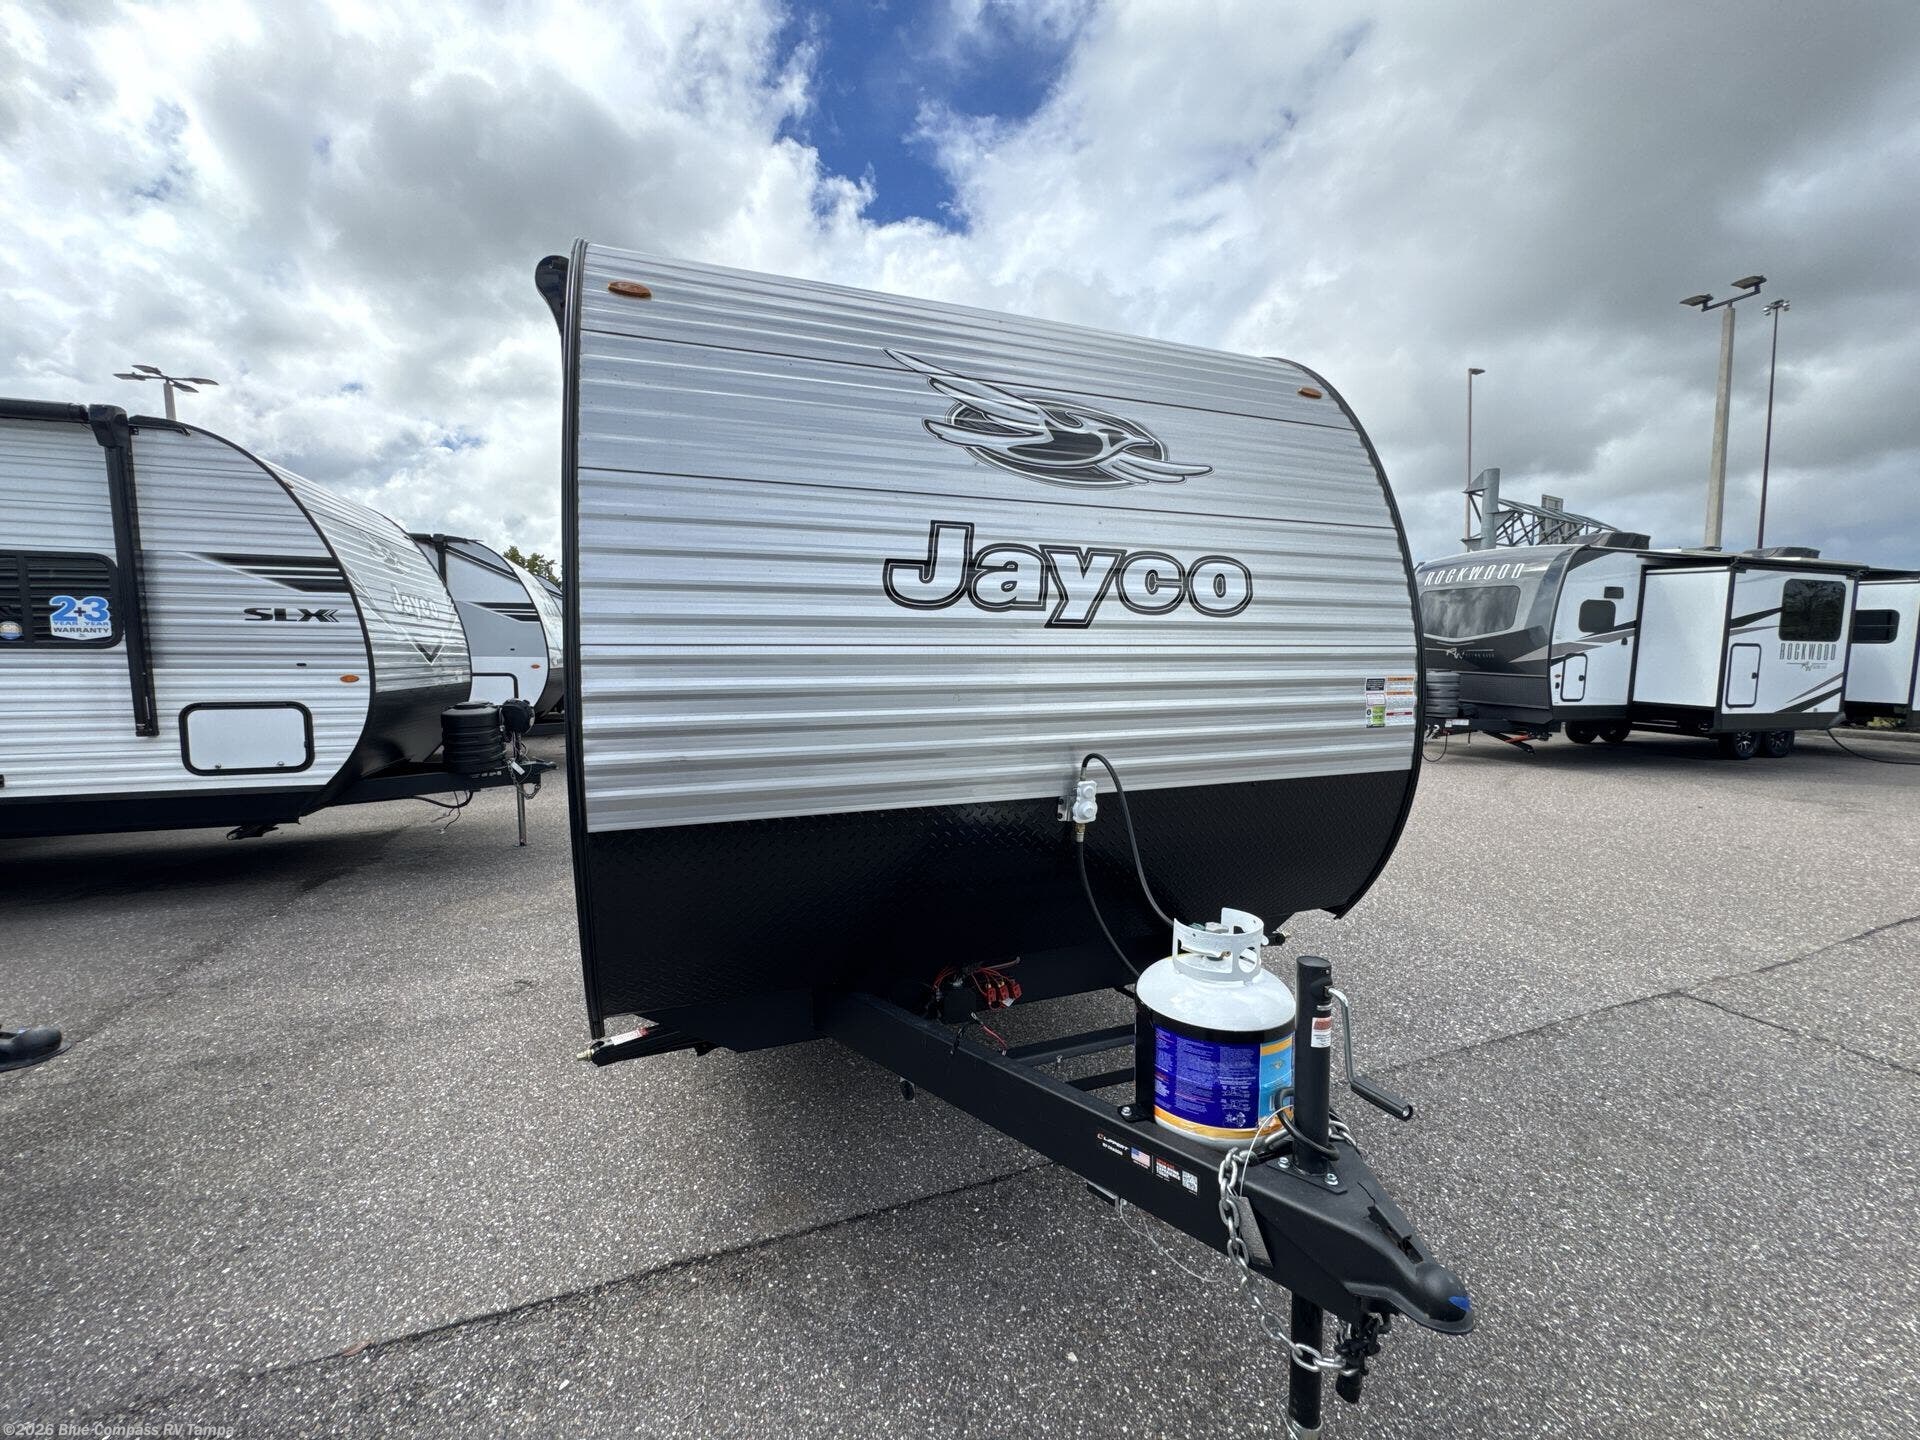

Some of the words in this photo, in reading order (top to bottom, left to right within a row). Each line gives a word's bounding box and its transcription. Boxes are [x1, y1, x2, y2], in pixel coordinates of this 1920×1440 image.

[883, 520, 1253, 629] Jayco
[1424, 563, 1525, 586] ROCKWOOD
[243, 607, 338, 622] SLX
[391, 584, 440, 622] Jayco
[1779, 642, 1837, 661] ROCKWOOD
